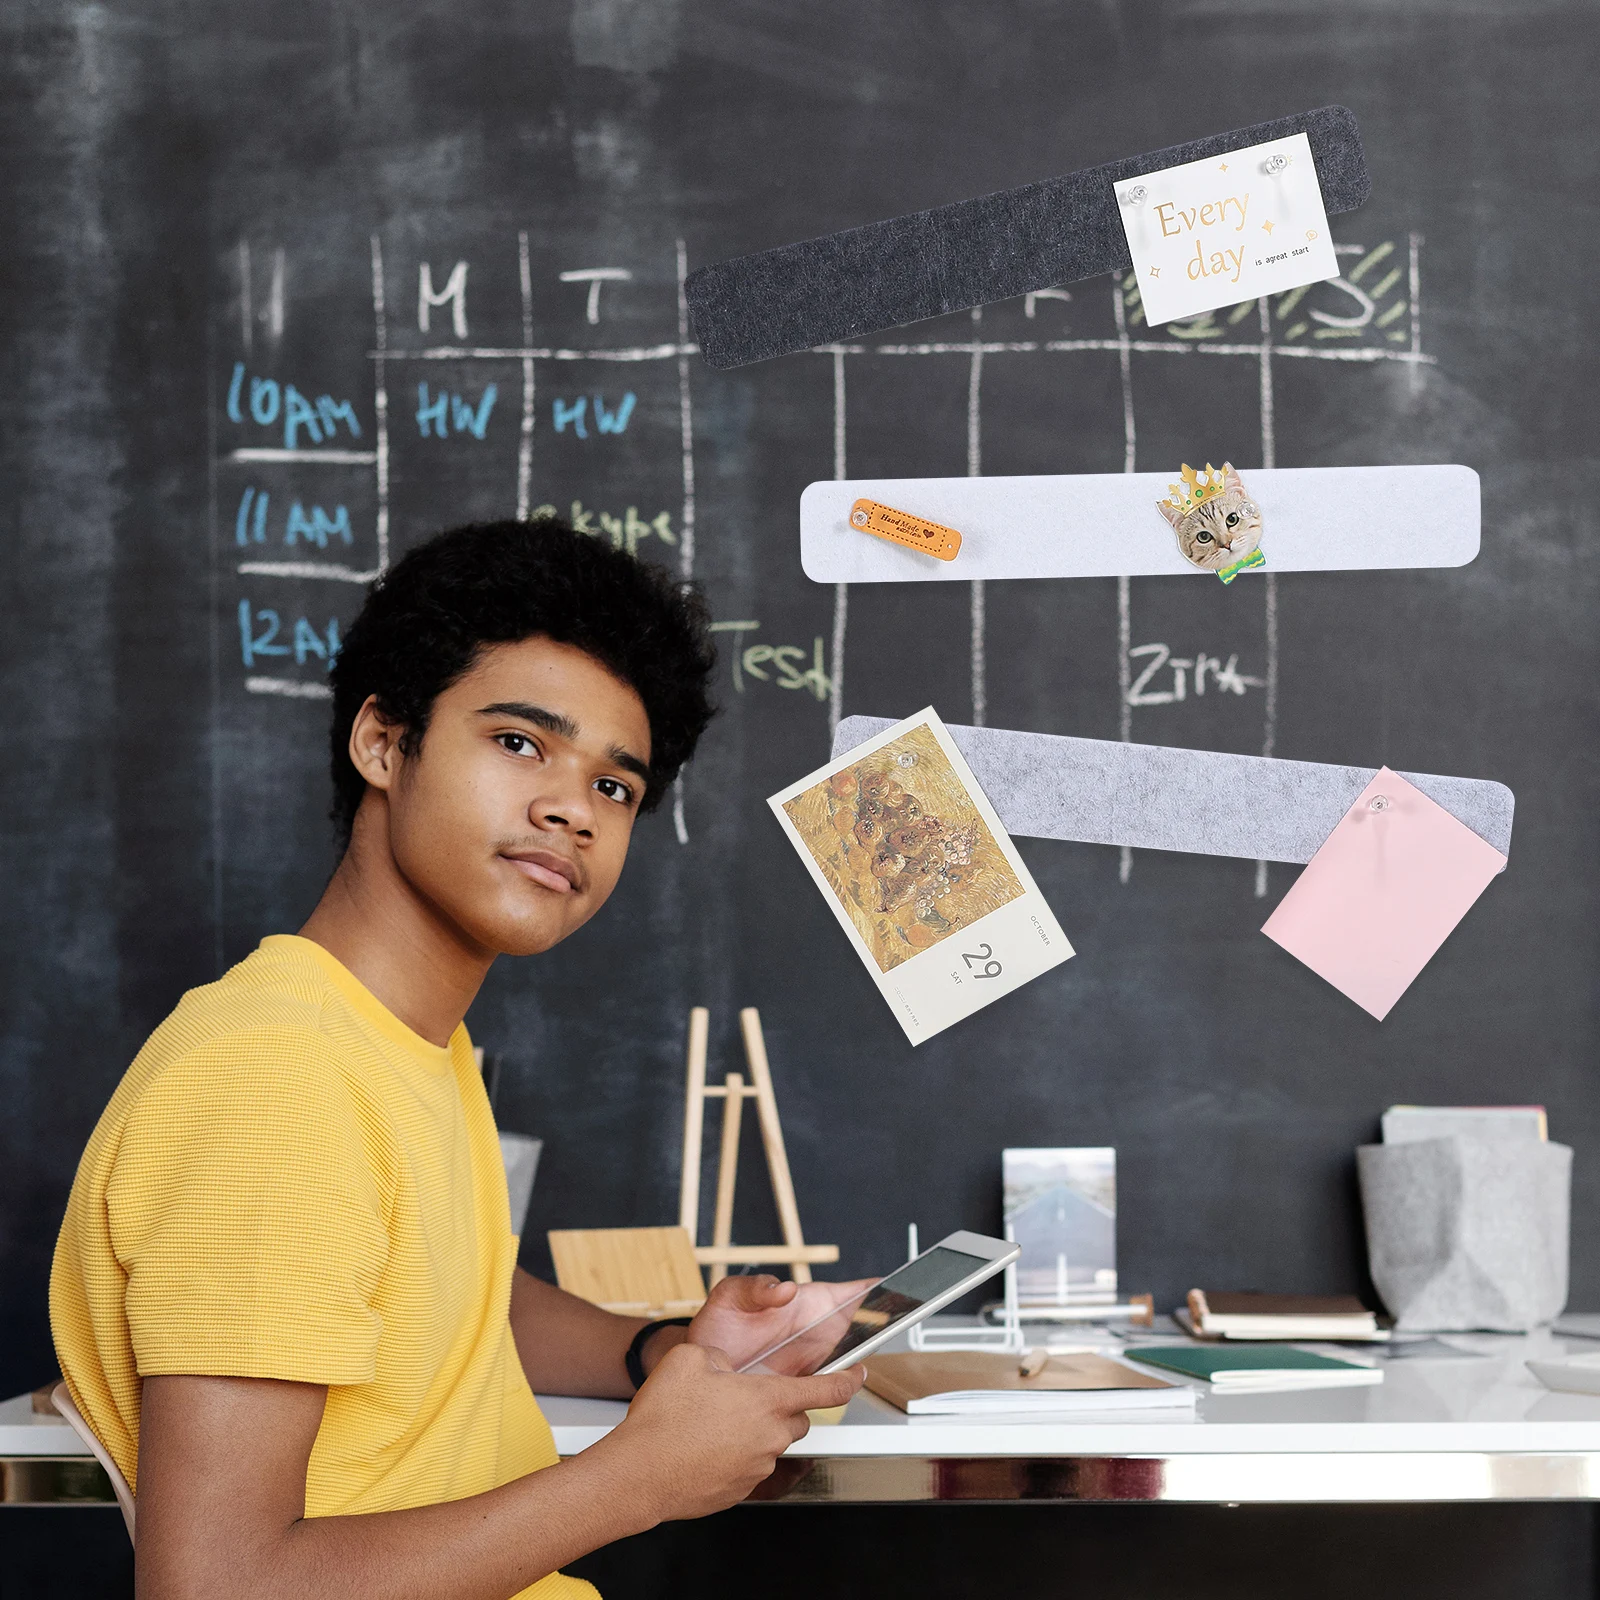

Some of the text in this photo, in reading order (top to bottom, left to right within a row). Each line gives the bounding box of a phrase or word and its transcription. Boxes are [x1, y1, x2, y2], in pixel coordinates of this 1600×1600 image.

[1153, 192, 1251, 238] Every
[1186, 239, 1246, 283] day
[1254, 259, 1263, 267] is
[1291, 246, 1310, 257] start
[418, 261, 468, 339] M
[559, 266, 633, 325] T
[414, 381, 498, 440] HW
[552, 392, 637, 439] HW
[880, 513, 901, 526] Hand
[899, 520, 920, 533] Made
[708, 620, 833, 699] Test
[1030, 915, 1051, 947] OCTOBER
[950, 971, 963, 986] SAT
[961, 943, 1003, 979] 29
